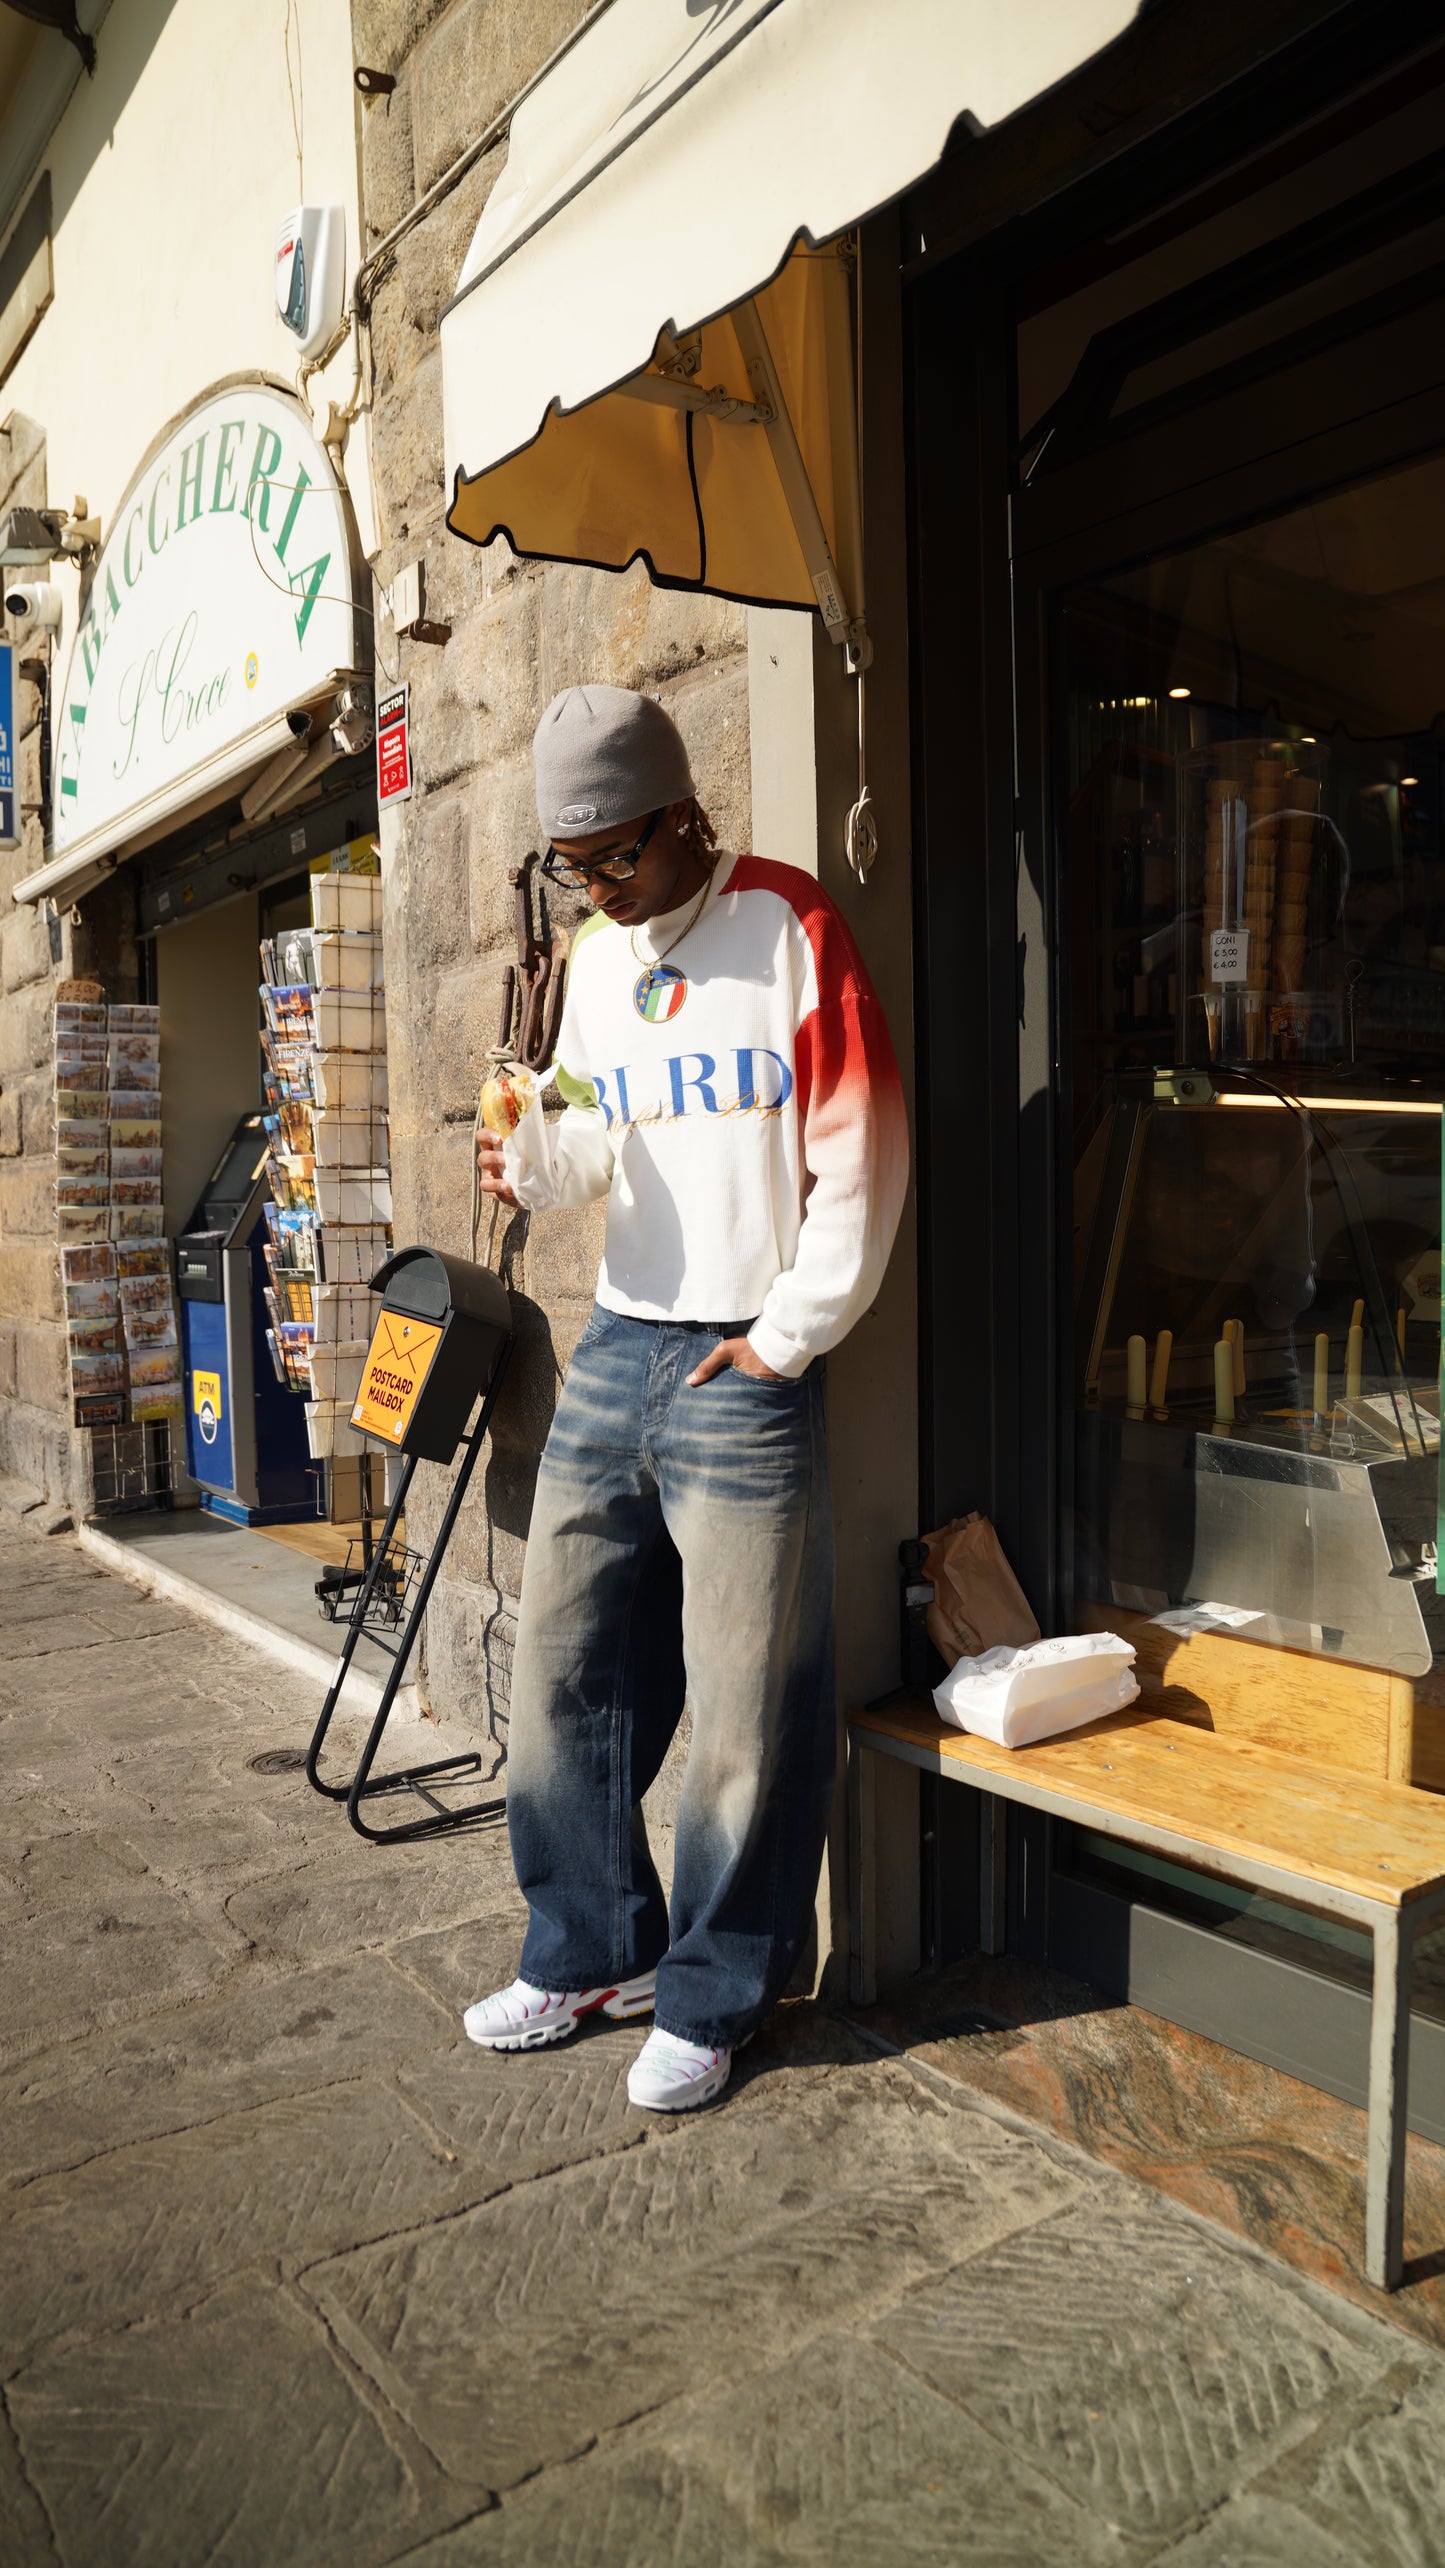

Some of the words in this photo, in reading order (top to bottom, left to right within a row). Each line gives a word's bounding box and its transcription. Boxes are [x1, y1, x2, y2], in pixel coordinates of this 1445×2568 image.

[60, 420, 331, 818] TABACCHERIA
[155, 610, 231, 744] Croce
[379, 694, 404, 717] SECTOR
[1216, 936, 1236, 945] CONI
[278, 1046, 311, 1059] FIRENZE
[199, 1381, 215, 1395] ATM
[369, 1367, 413, 1395] POSTCARD
[367, 1386, 405, 1413] MAILBOX
